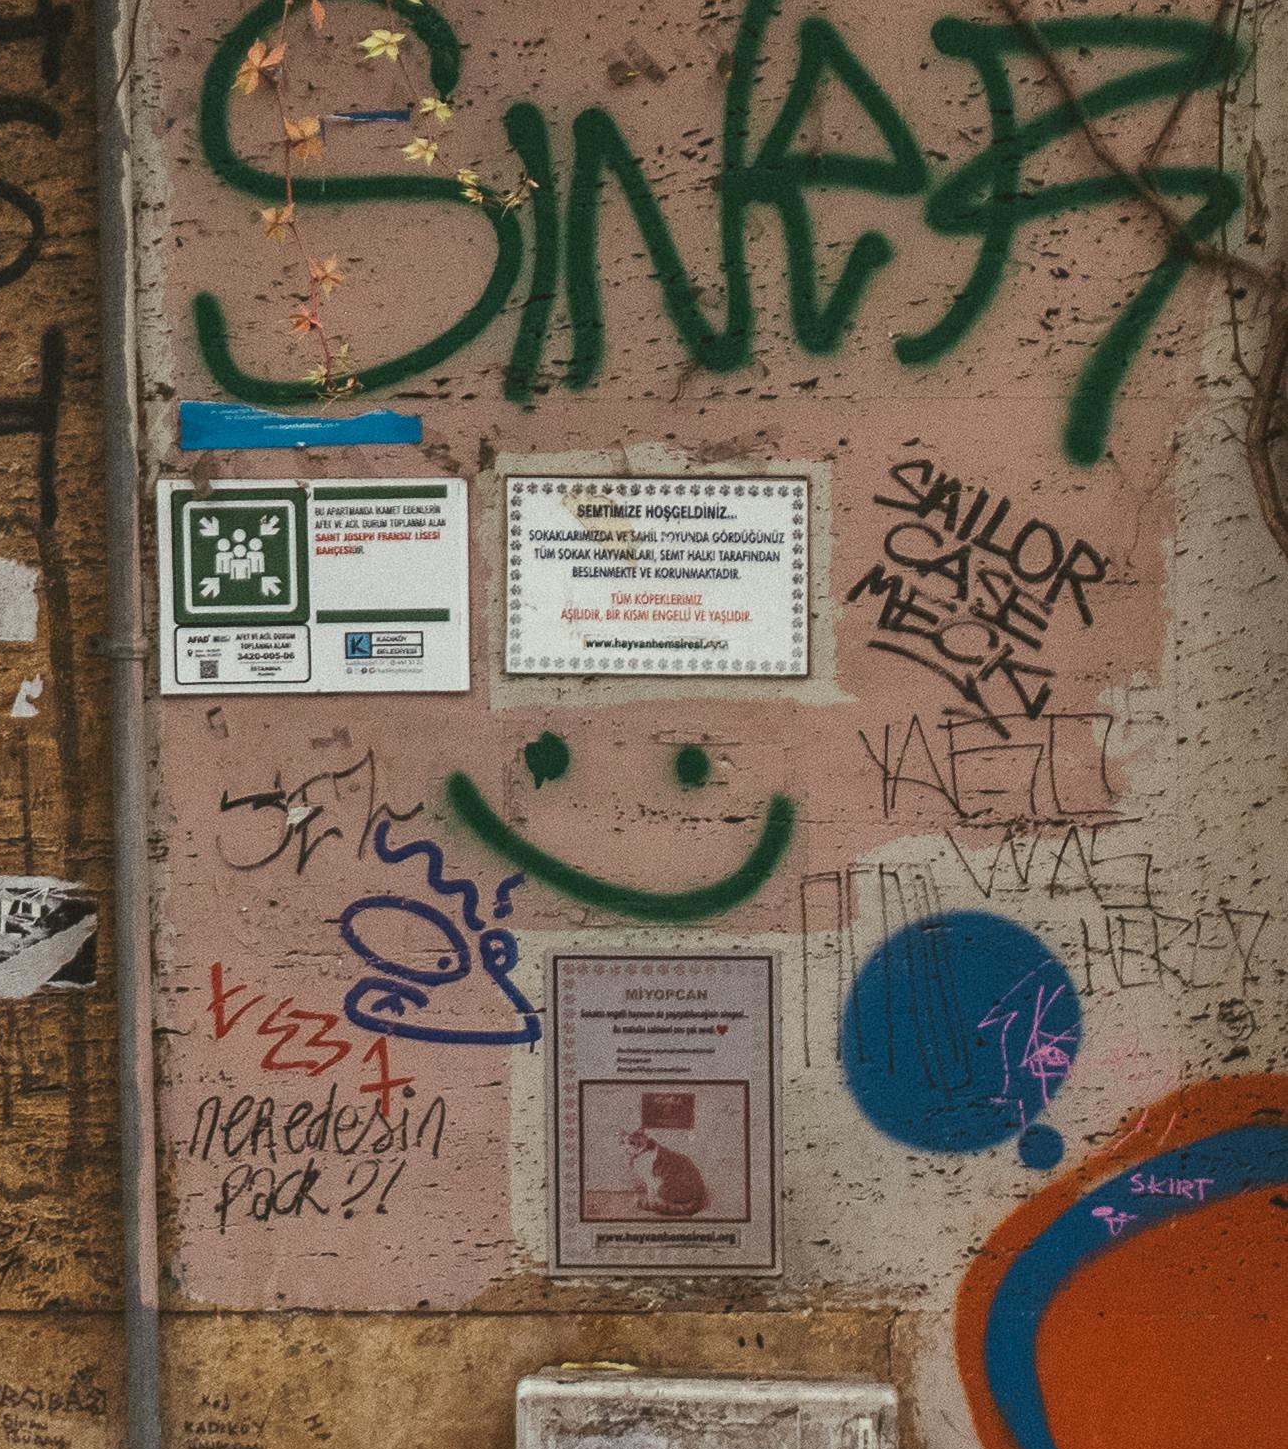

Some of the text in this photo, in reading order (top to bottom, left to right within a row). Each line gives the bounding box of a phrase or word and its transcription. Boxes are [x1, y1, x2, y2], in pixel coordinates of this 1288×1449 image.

[327, 505, 374, 516] APARTMANDA
[577, 501, 642, 519] SEMTİMİZE
[362, 518, 388, 528] DURUM
[315, 532, 341, 543] SAINT
[343, 531, 375, 542] JOSEPH
[377, 531, 413, 541] FRANSIZ
[528, 529, 613, 542] SOKAKLARIMIZDA
[615, 530, 629, 542] VE
[630, 527, 658, 543] SAHİL
[712, 527, 785, 545] GÖRDÜĞÜNÜZ
[534, 545, 556, 561] TÜM
[558, 548, 591, 561] SOKAK
[660, 549, 685, 562] SEMT
[687, 549, 716, 562] HALKI
[718, 549, 781, 563] TARAFINDAN
[572, 565, 742, 580] BESLENMEKTE VE KORUNMAKTADIR.
[611, 590, 703, 606] TÜM KÖPEKLERİMİZ
[694, 608, 706, 622] VE
[625, 985, 708, 1001] MİYOPCAN
[1129, 1172, 1215, 1201] SKIRT
